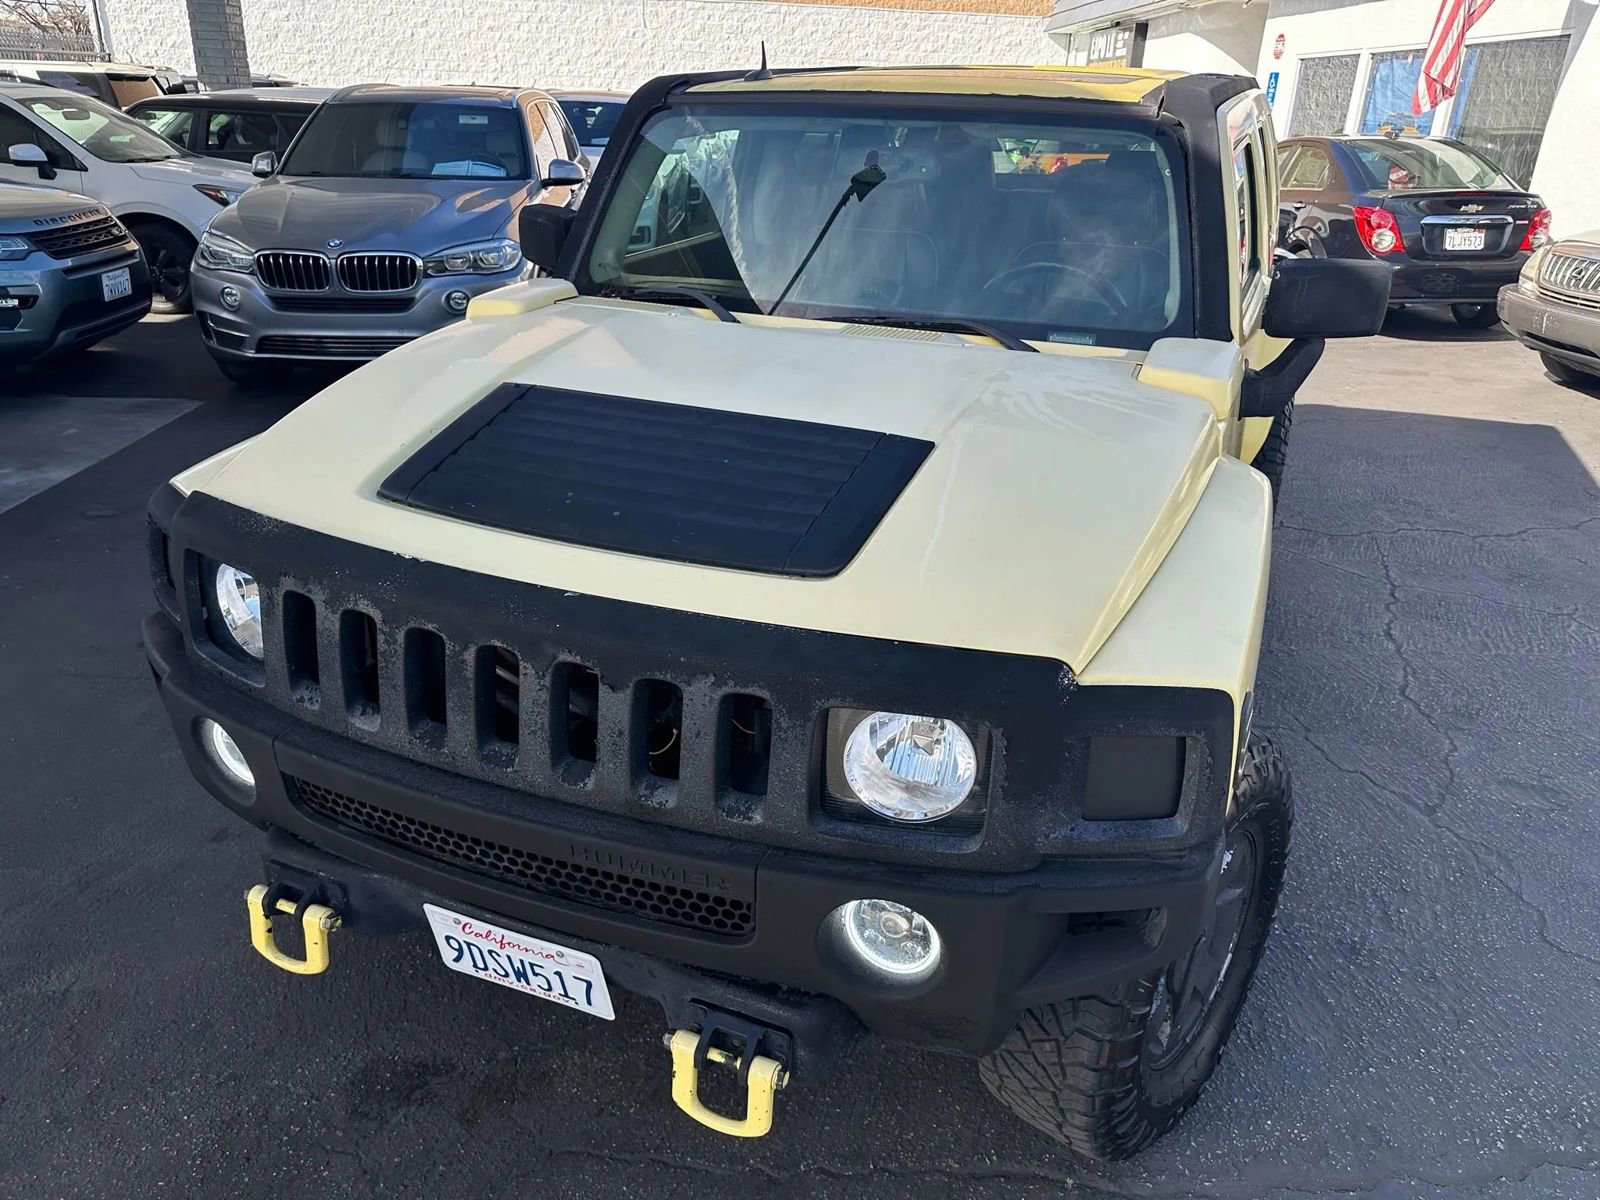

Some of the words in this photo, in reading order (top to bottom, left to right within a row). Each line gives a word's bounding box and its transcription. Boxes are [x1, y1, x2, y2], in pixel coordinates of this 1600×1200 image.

[33, 208, 102, 226] DISCOVERY
[1448, 235, 1483, 248] 7LJY573
[570, 844, 731, 892] HUMMER
[461, 921, 568, 967] California
[444, 934, 594, 1007] 9DSW517
